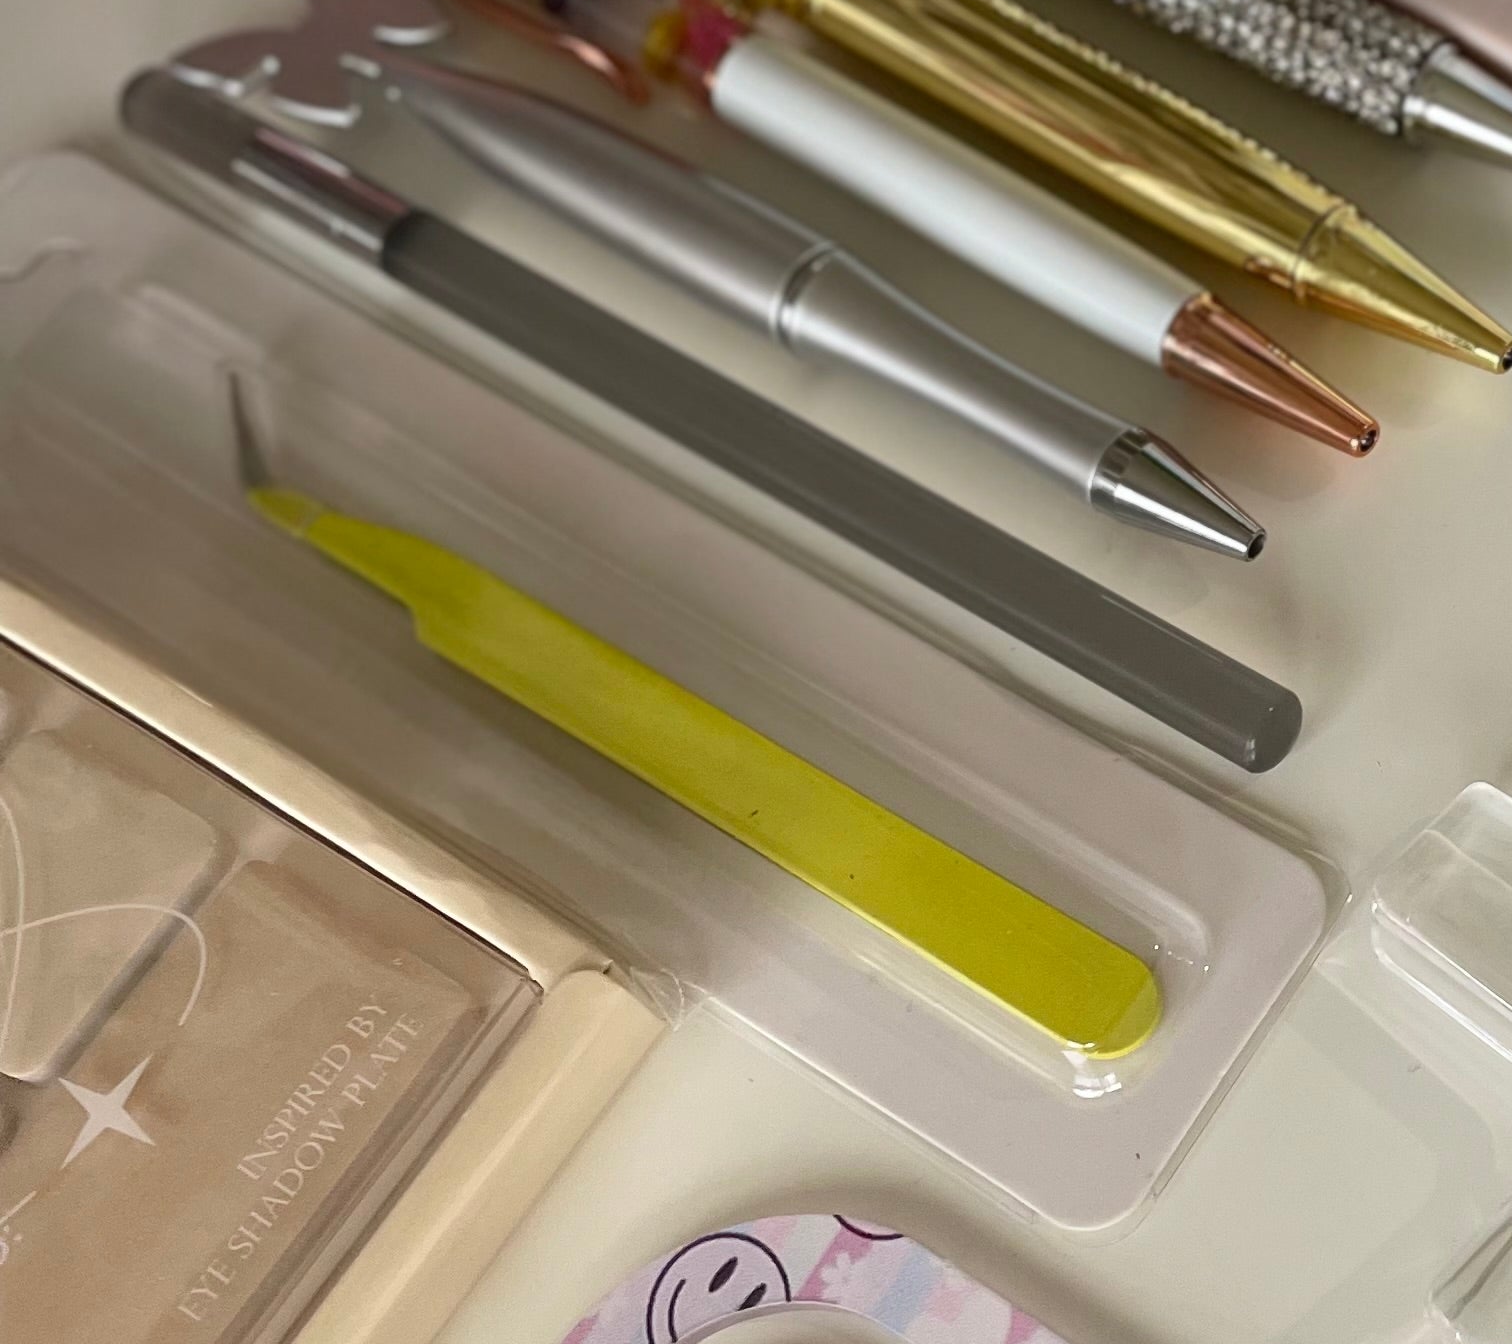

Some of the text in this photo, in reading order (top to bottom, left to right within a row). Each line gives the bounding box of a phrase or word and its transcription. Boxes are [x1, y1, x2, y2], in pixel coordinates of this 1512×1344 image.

[177, 1013, 424, 1320] EYE SHADOW PLATE
[236, 994, 388, 1180] INSPIRED BY
